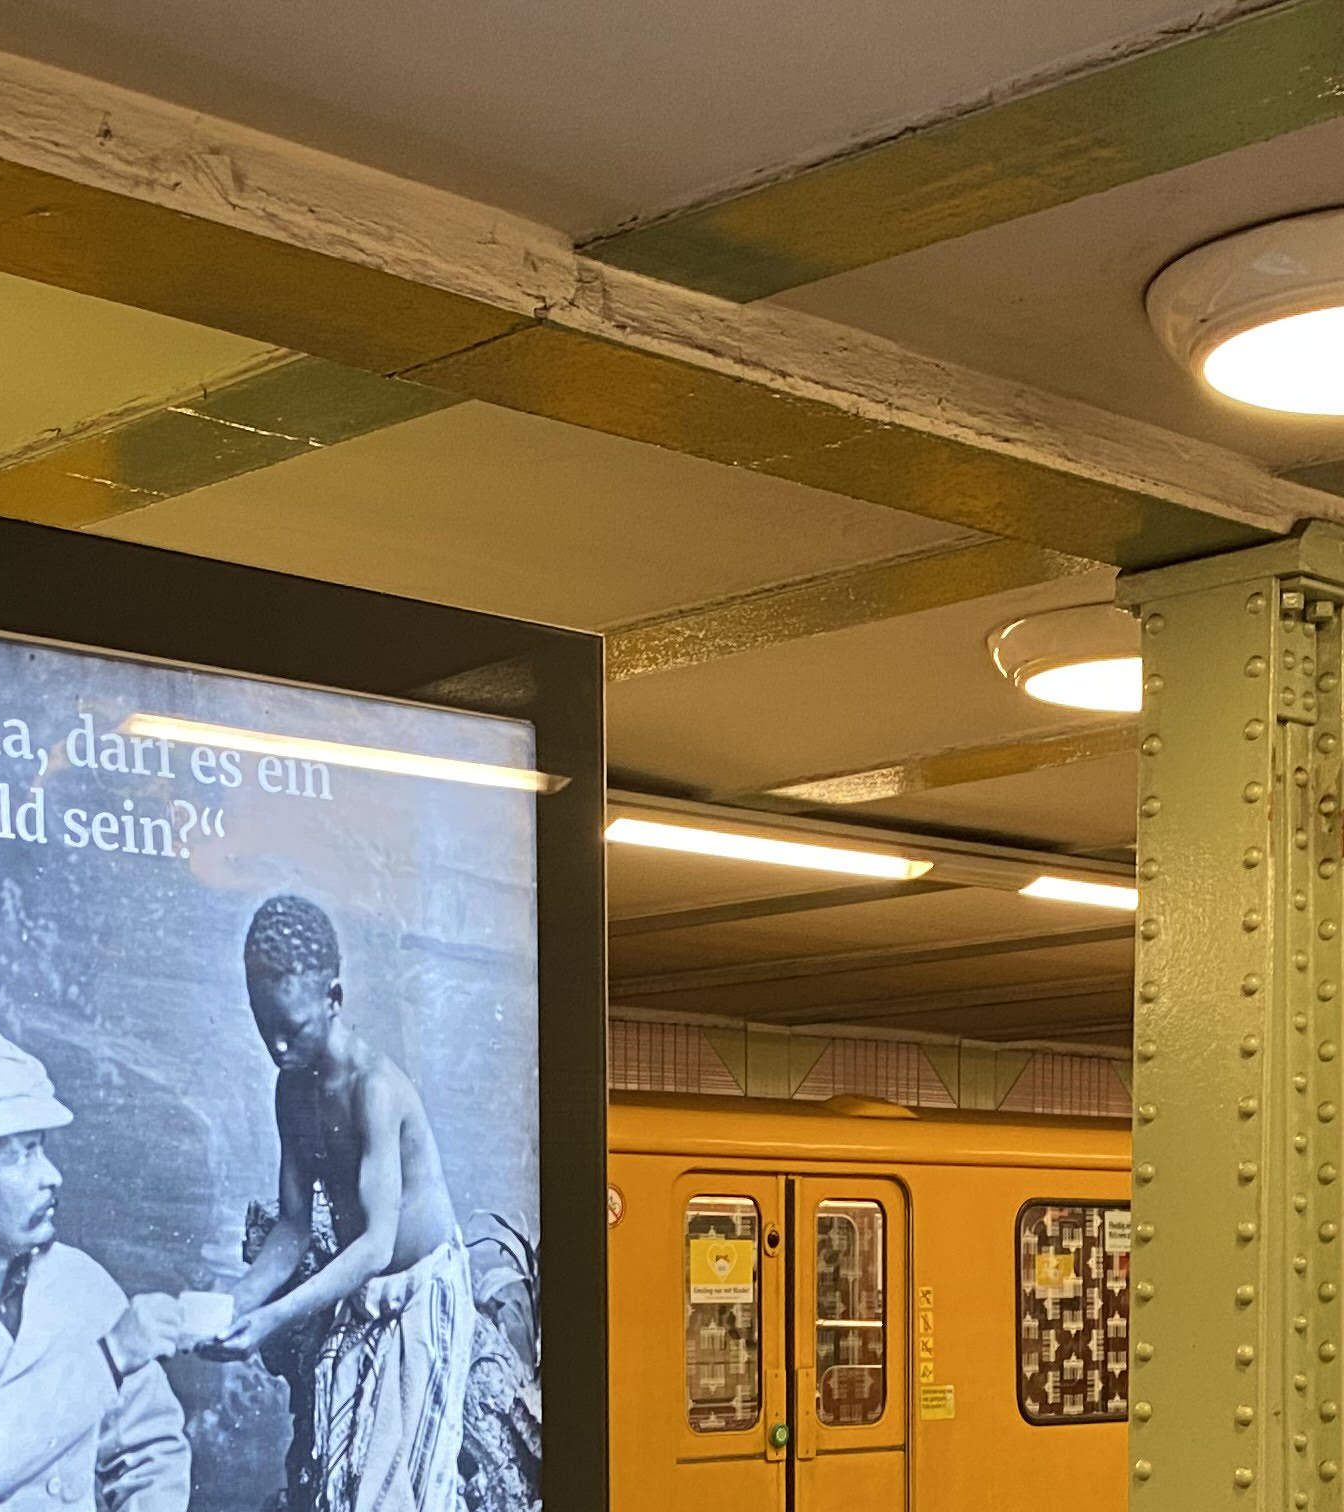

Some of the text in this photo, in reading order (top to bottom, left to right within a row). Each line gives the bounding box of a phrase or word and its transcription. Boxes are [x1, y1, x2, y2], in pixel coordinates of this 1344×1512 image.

[66, 713, 176, 779] darf
[191, 746, 243, 788] es
[258, 756, 334, 800] ein
